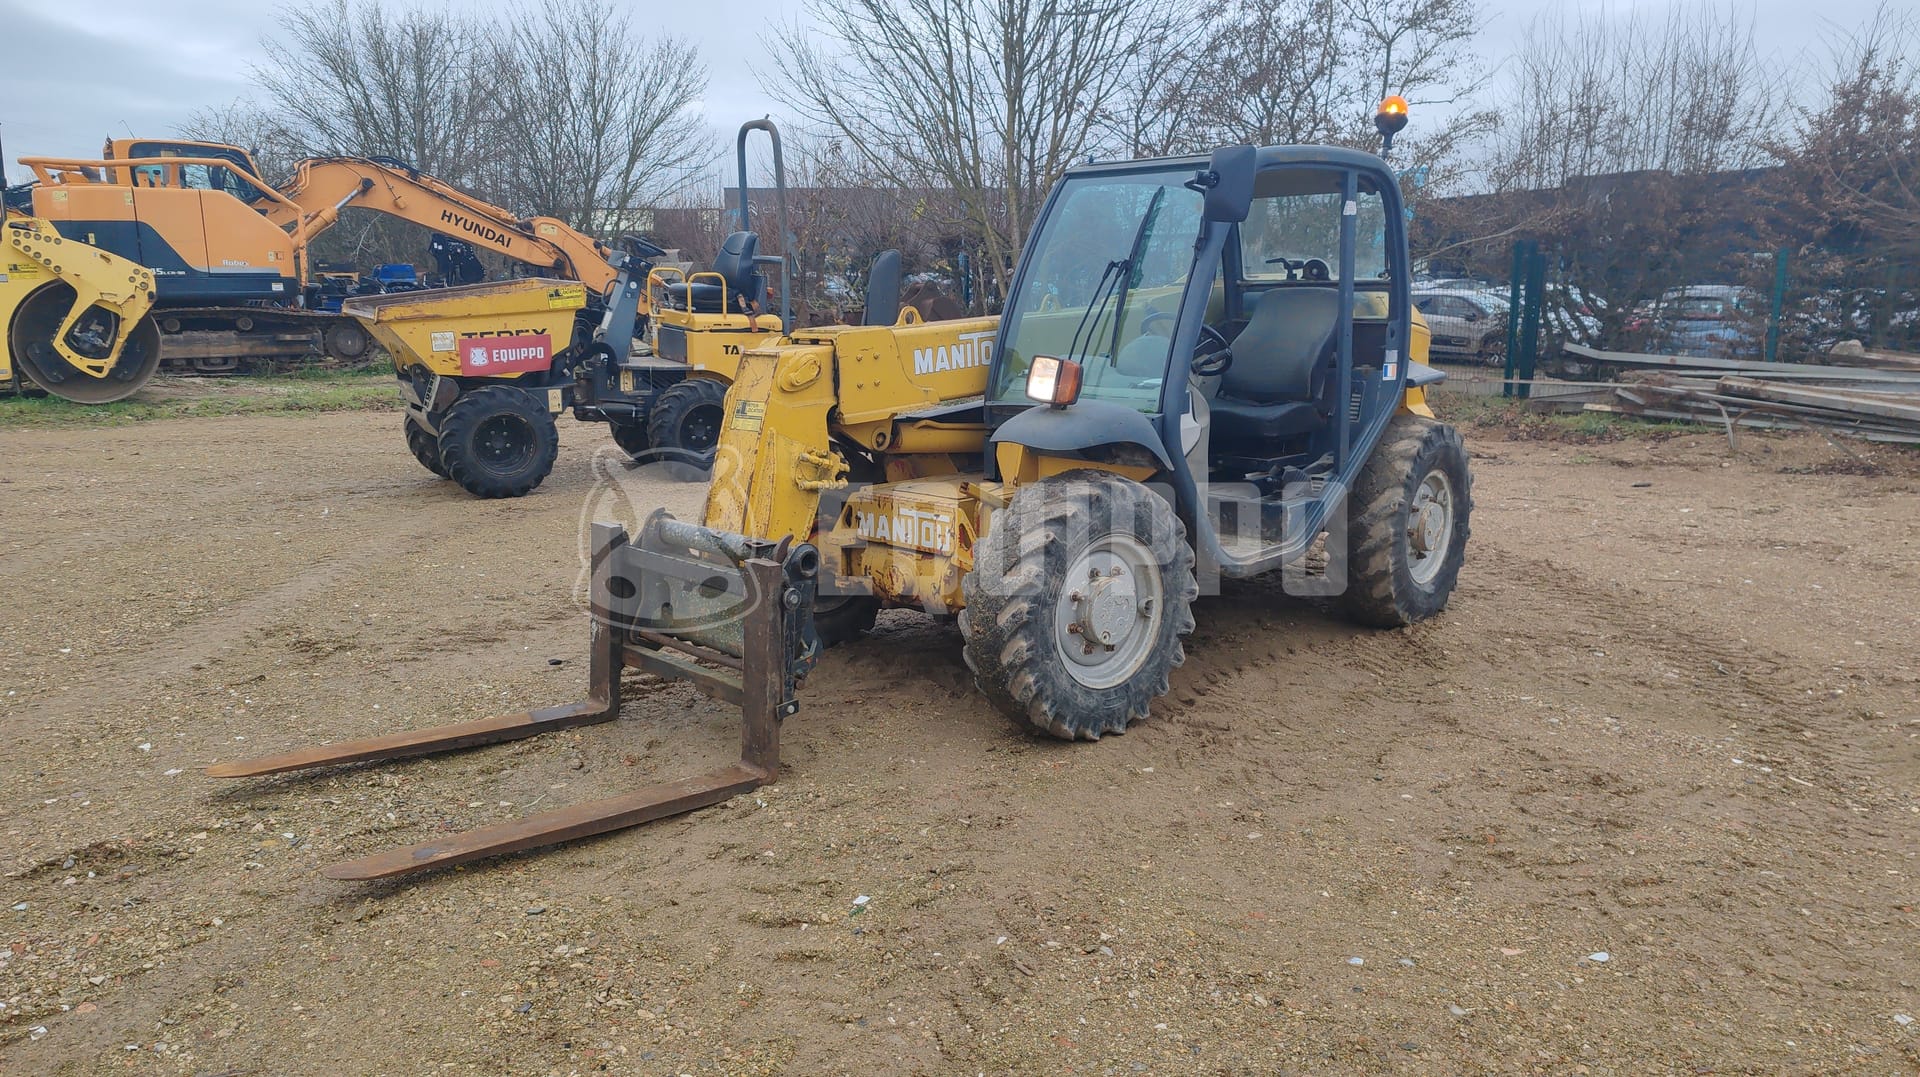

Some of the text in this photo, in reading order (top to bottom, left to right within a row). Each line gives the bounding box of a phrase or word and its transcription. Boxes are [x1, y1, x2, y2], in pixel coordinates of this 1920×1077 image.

[441, 210, 512, 248] HYUNDAI
[492, 346, 544, 363] EQUIPPO
[722, 344, 740, 355] TA
[914, 329, 998, 375] MANITO
[857, 508, 951, 551] MANITOU
